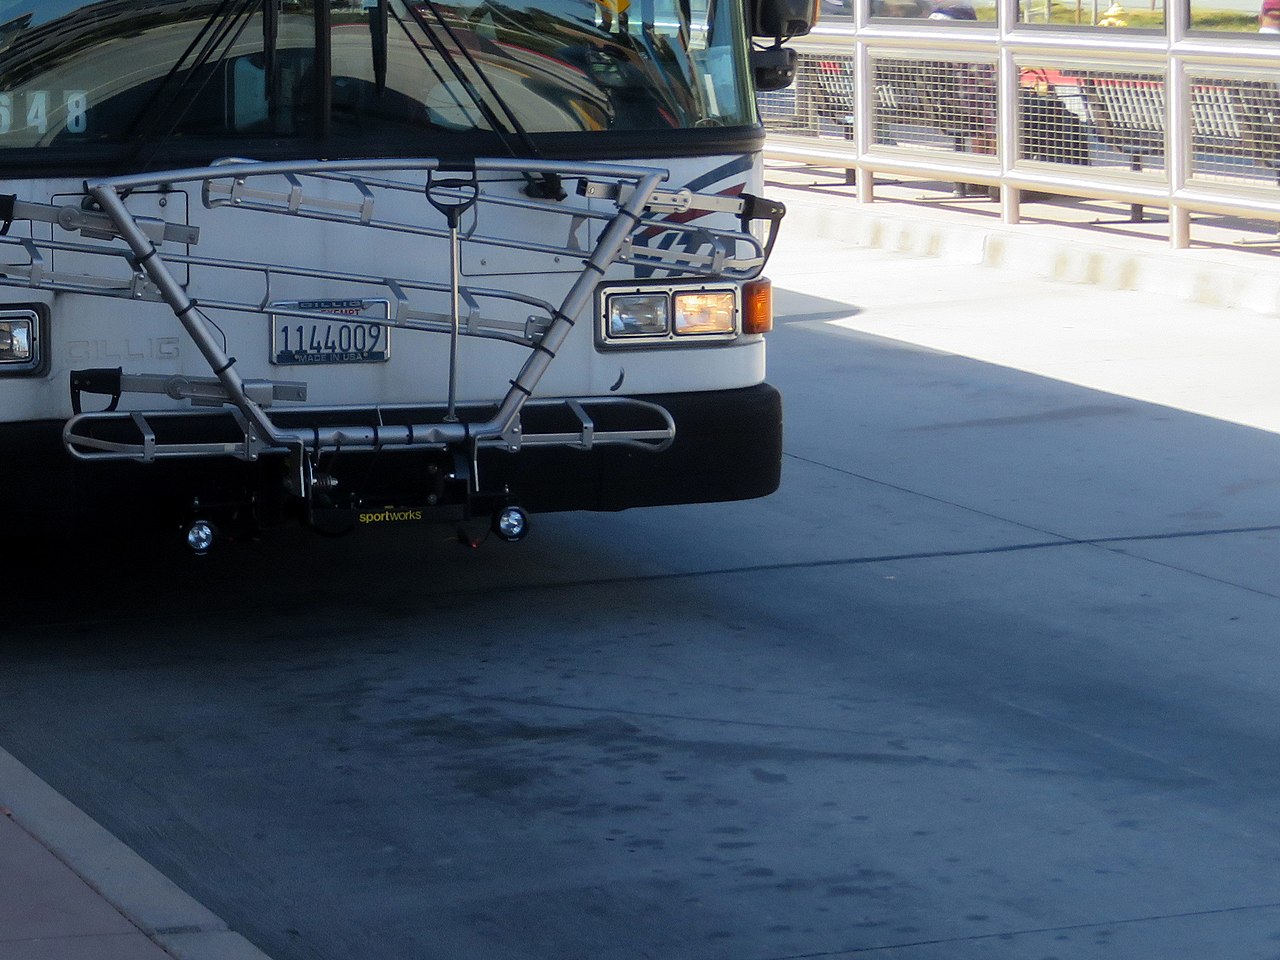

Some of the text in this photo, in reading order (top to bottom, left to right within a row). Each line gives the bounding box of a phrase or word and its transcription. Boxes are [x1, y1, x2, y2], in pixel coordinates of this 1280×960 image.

[281, 324, 381, 353] 1144009
[66, 337, 180, 361] GILLIG
[298, 352, 363, 362] MADE IN USA
[360, 510, 422, 523] sportworks
